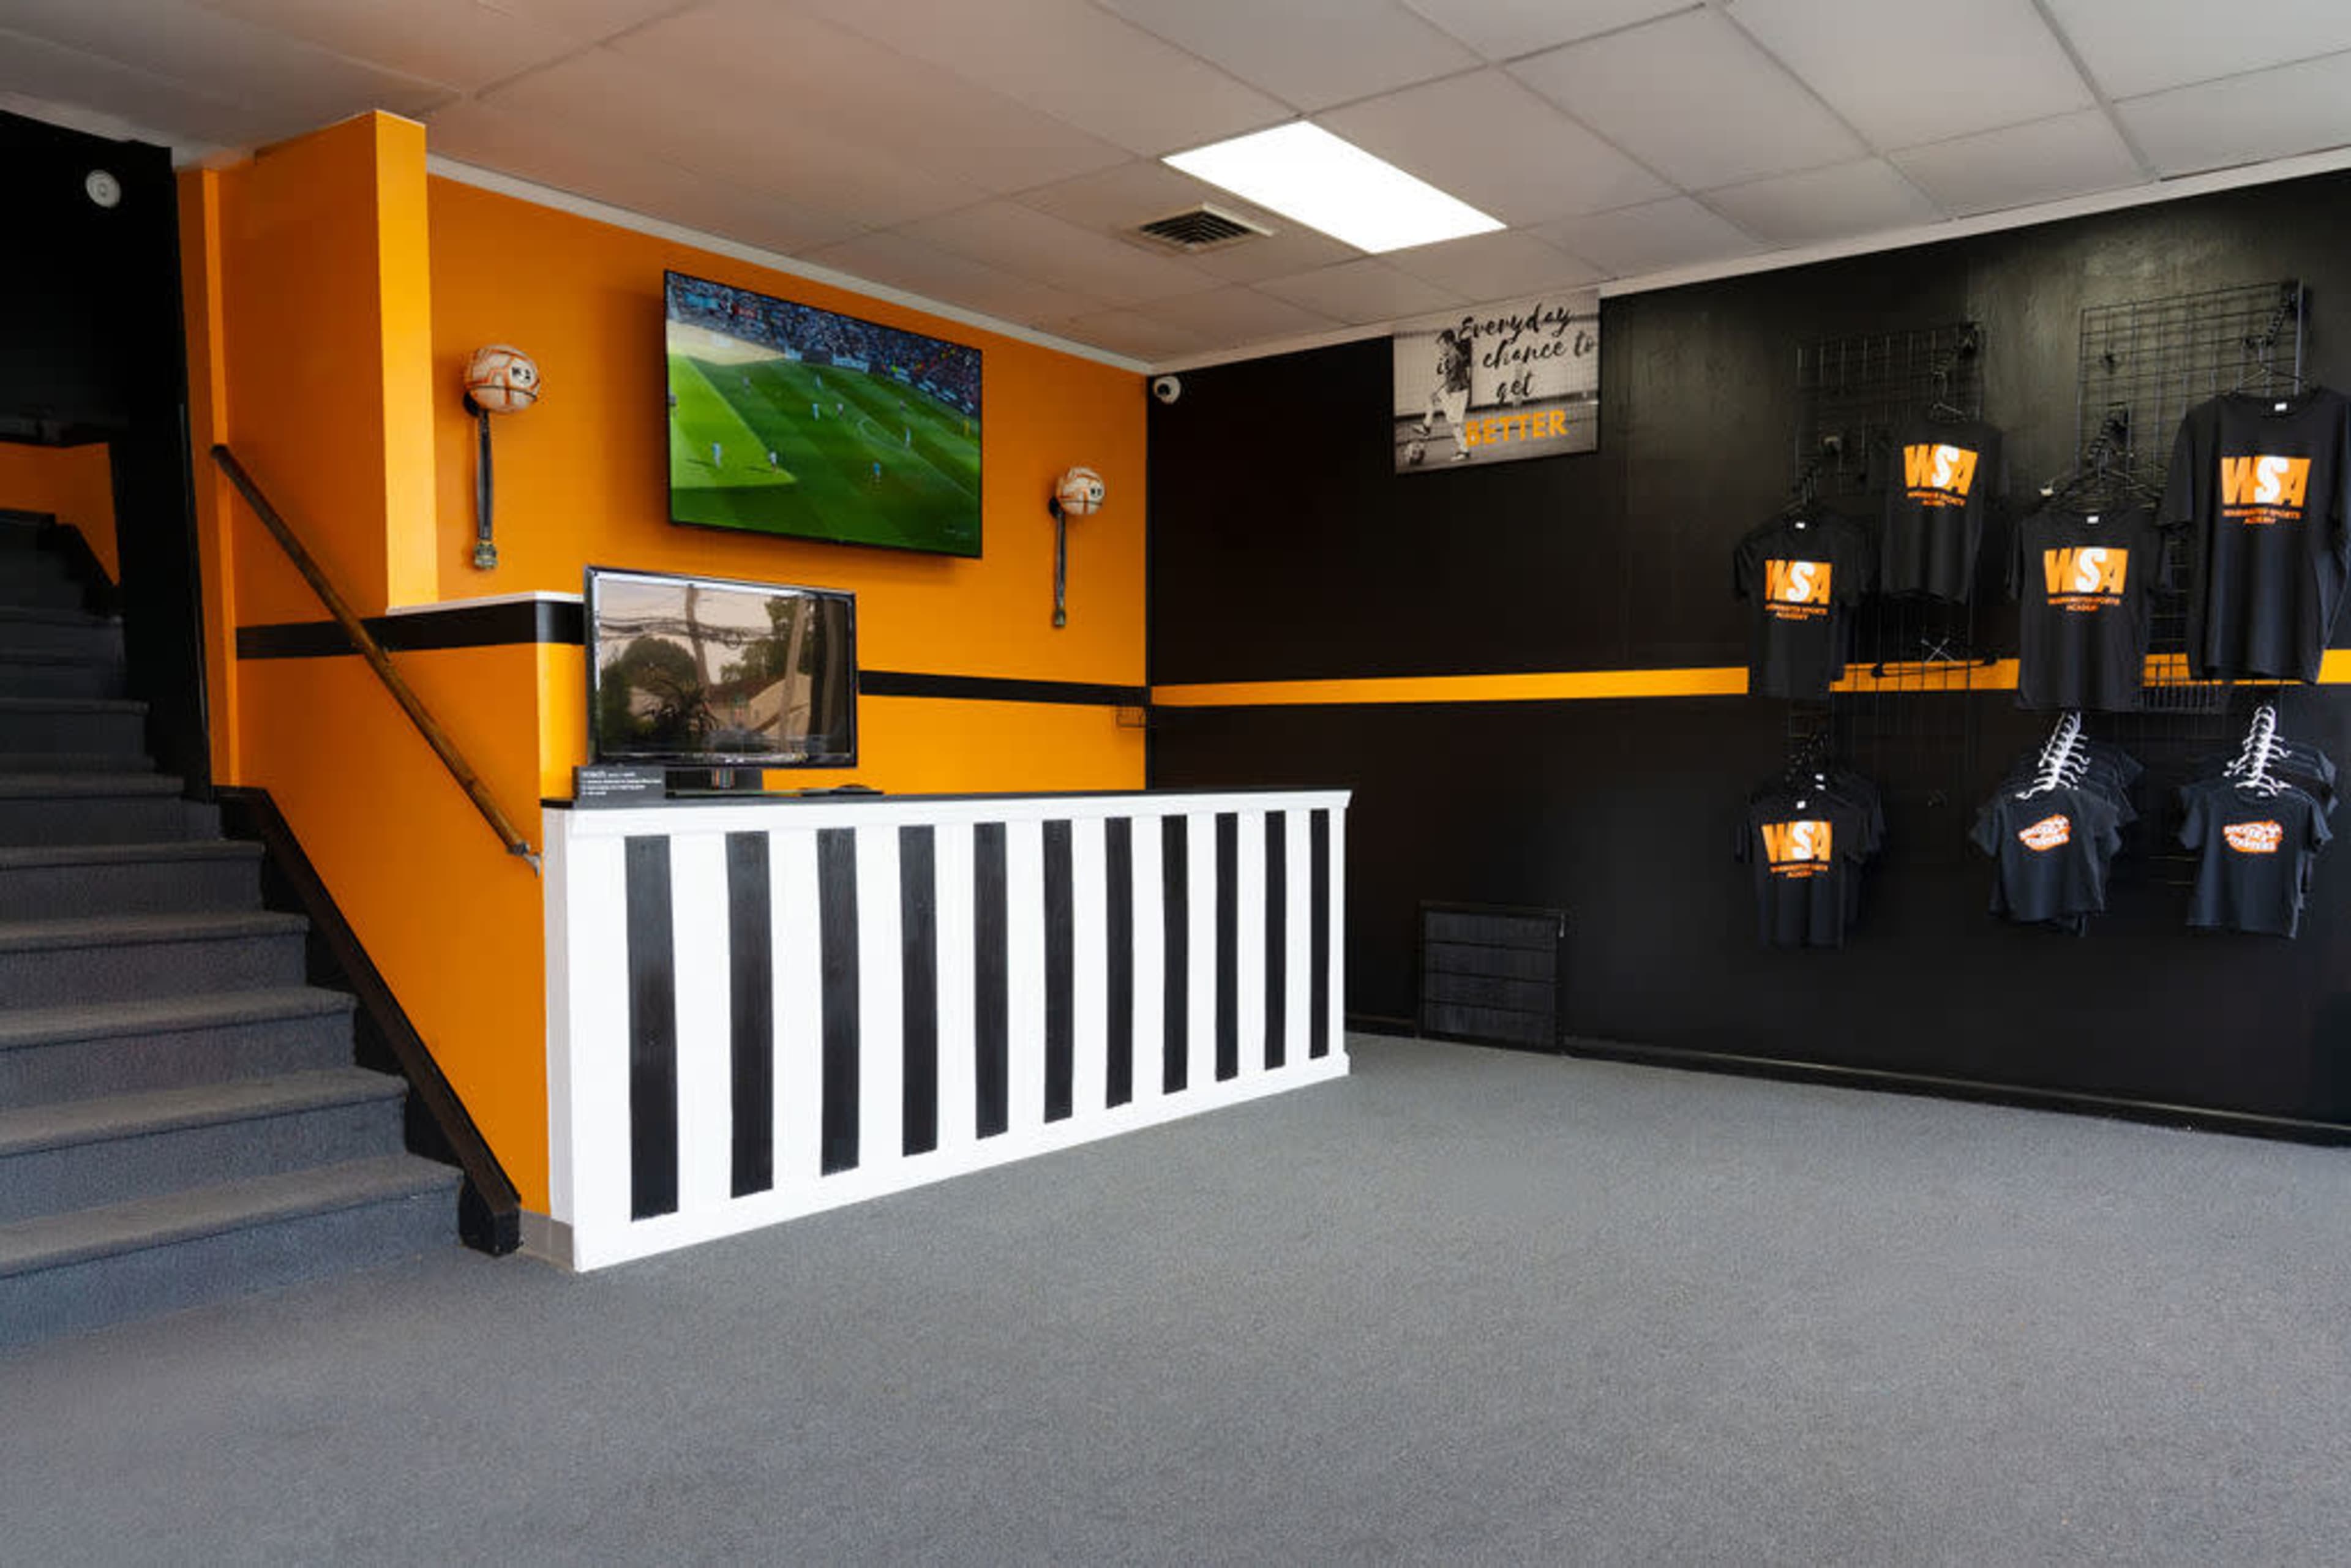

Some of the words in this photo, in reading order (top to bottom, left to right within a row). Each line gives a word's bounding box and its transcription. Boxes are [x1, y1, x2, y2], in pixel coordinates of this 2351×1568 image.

[1457, 303, 1572, 344] Everyday
[1483, 339, 1567, 370] chance
[1573, 331, 1594, 357] to
[1496, 372, 1532, 405] get
[1466, 409, 1569, 446] BETTER
[1903, 443, 1978, 495] WSA
[2221, 455, 2311, 507] WSA
[1765, 559, 1831, 604] WSA
[2044, 547, 2128, 595] WSA
[1761, 820, 1832, 863] WSA
